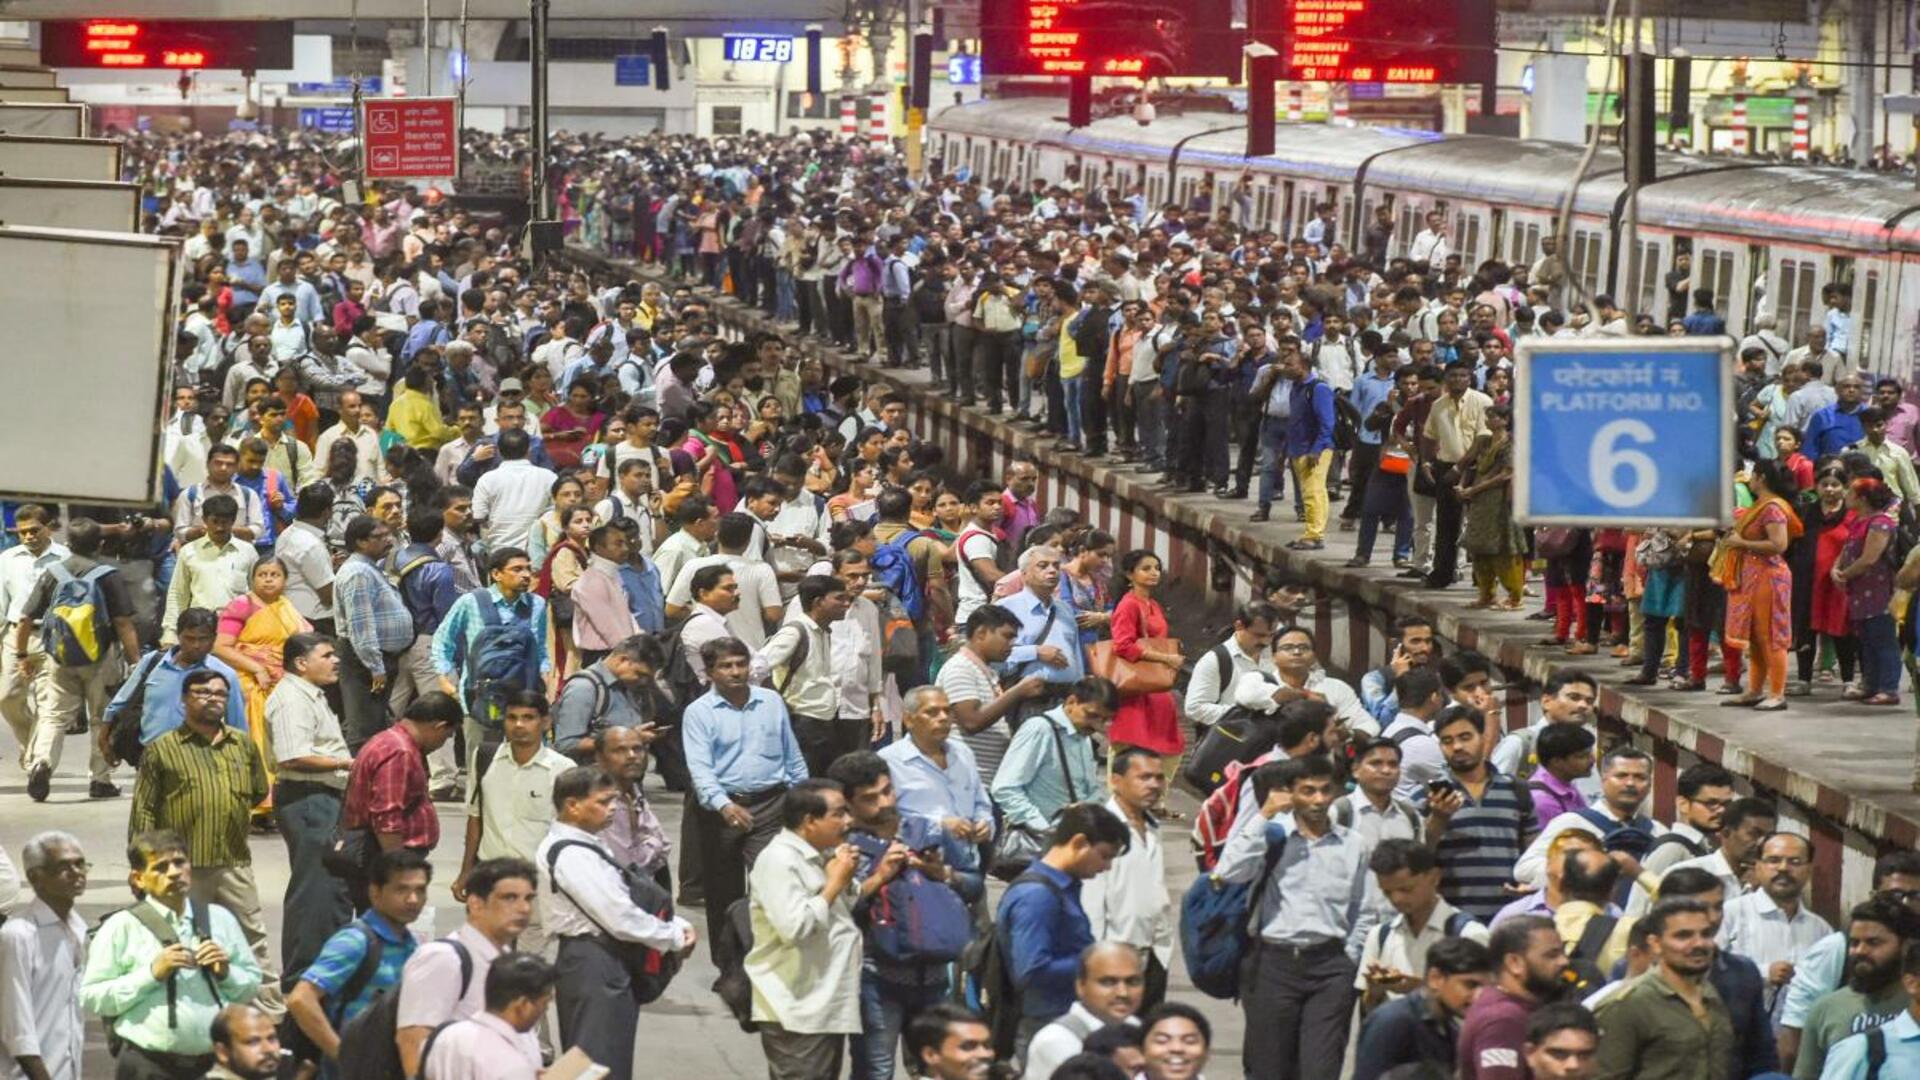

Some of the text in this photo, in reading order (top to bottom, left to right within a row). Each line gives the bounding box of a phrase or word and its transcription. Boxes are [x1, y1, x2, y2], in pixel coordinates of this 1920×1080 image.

[1292, 54, 1339, 66] KALYAN
[1541, 392, 1663, 412] PLATFORM
[1589, 418, 1659, 508] 6
